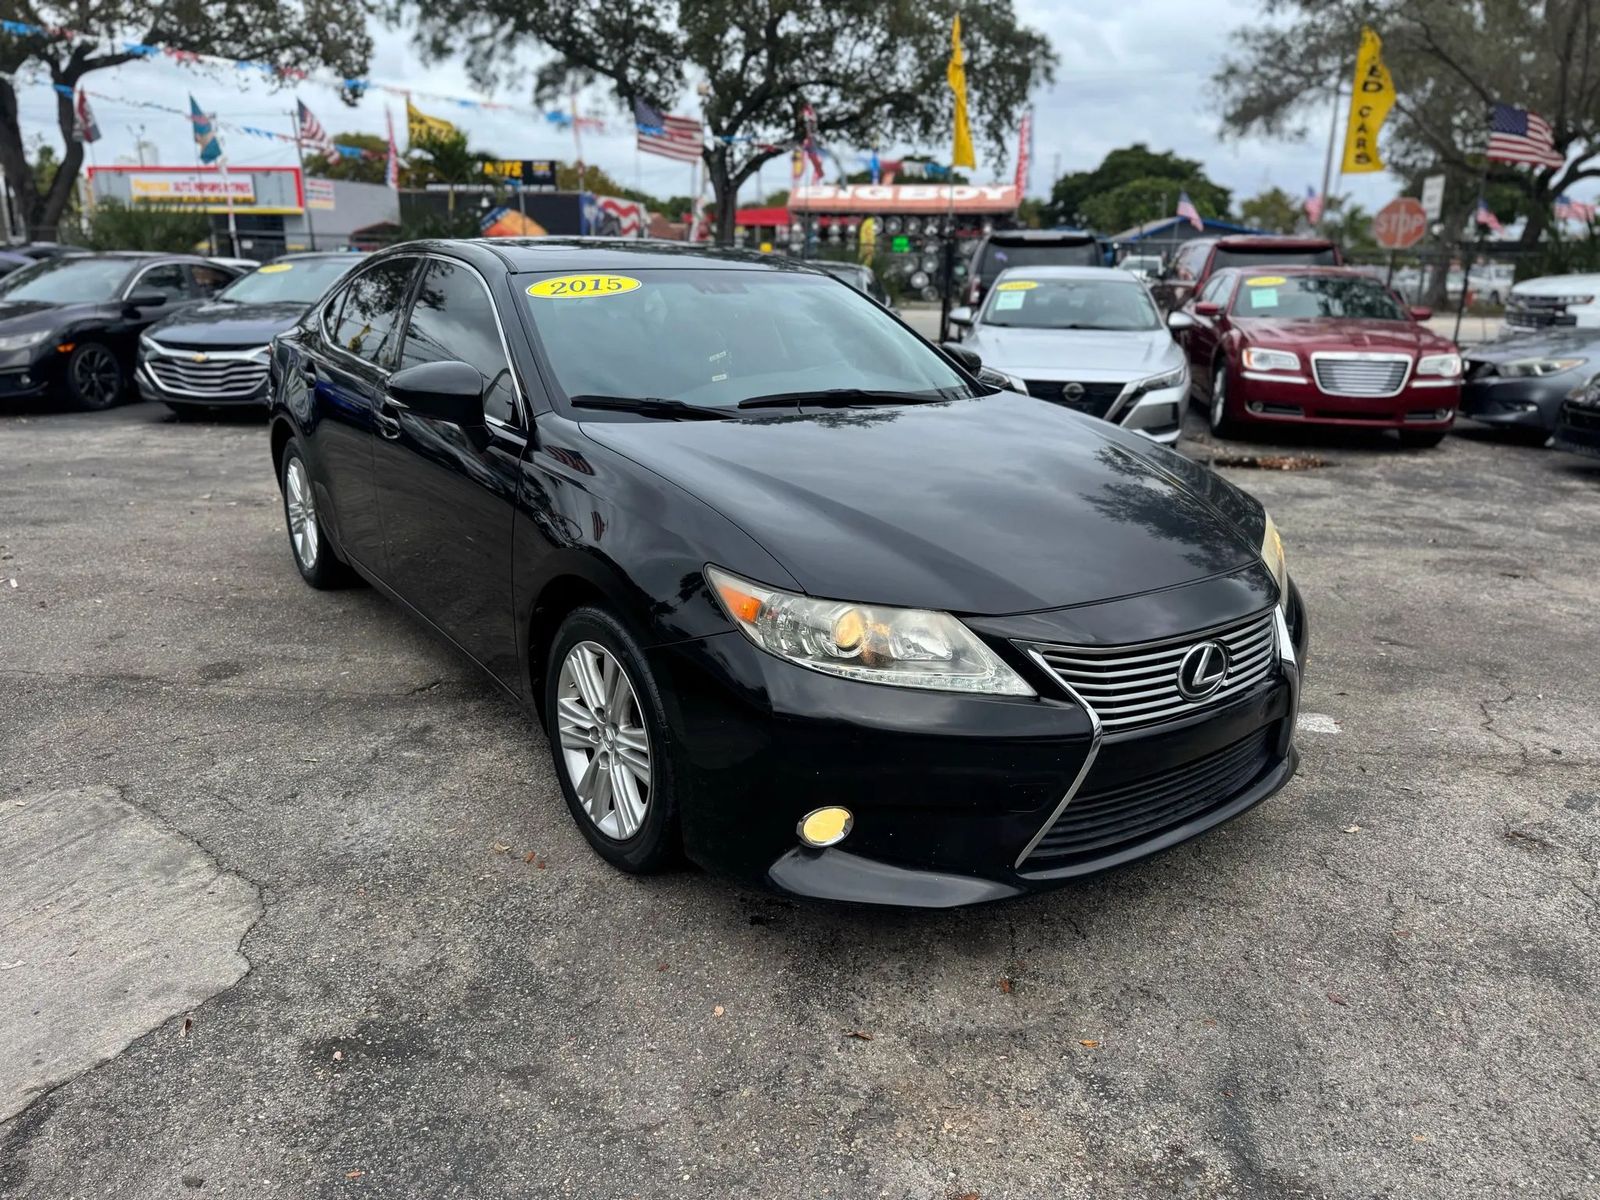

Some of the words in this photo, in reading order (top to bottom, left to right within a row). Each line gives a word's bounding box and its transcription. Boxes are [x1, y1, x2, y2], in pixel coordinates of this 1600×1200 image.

[1354, 105, 1372, 165] CARS
[1376, 212, 1424, 233] STOP
[549, 278, 623, 296] 2015
